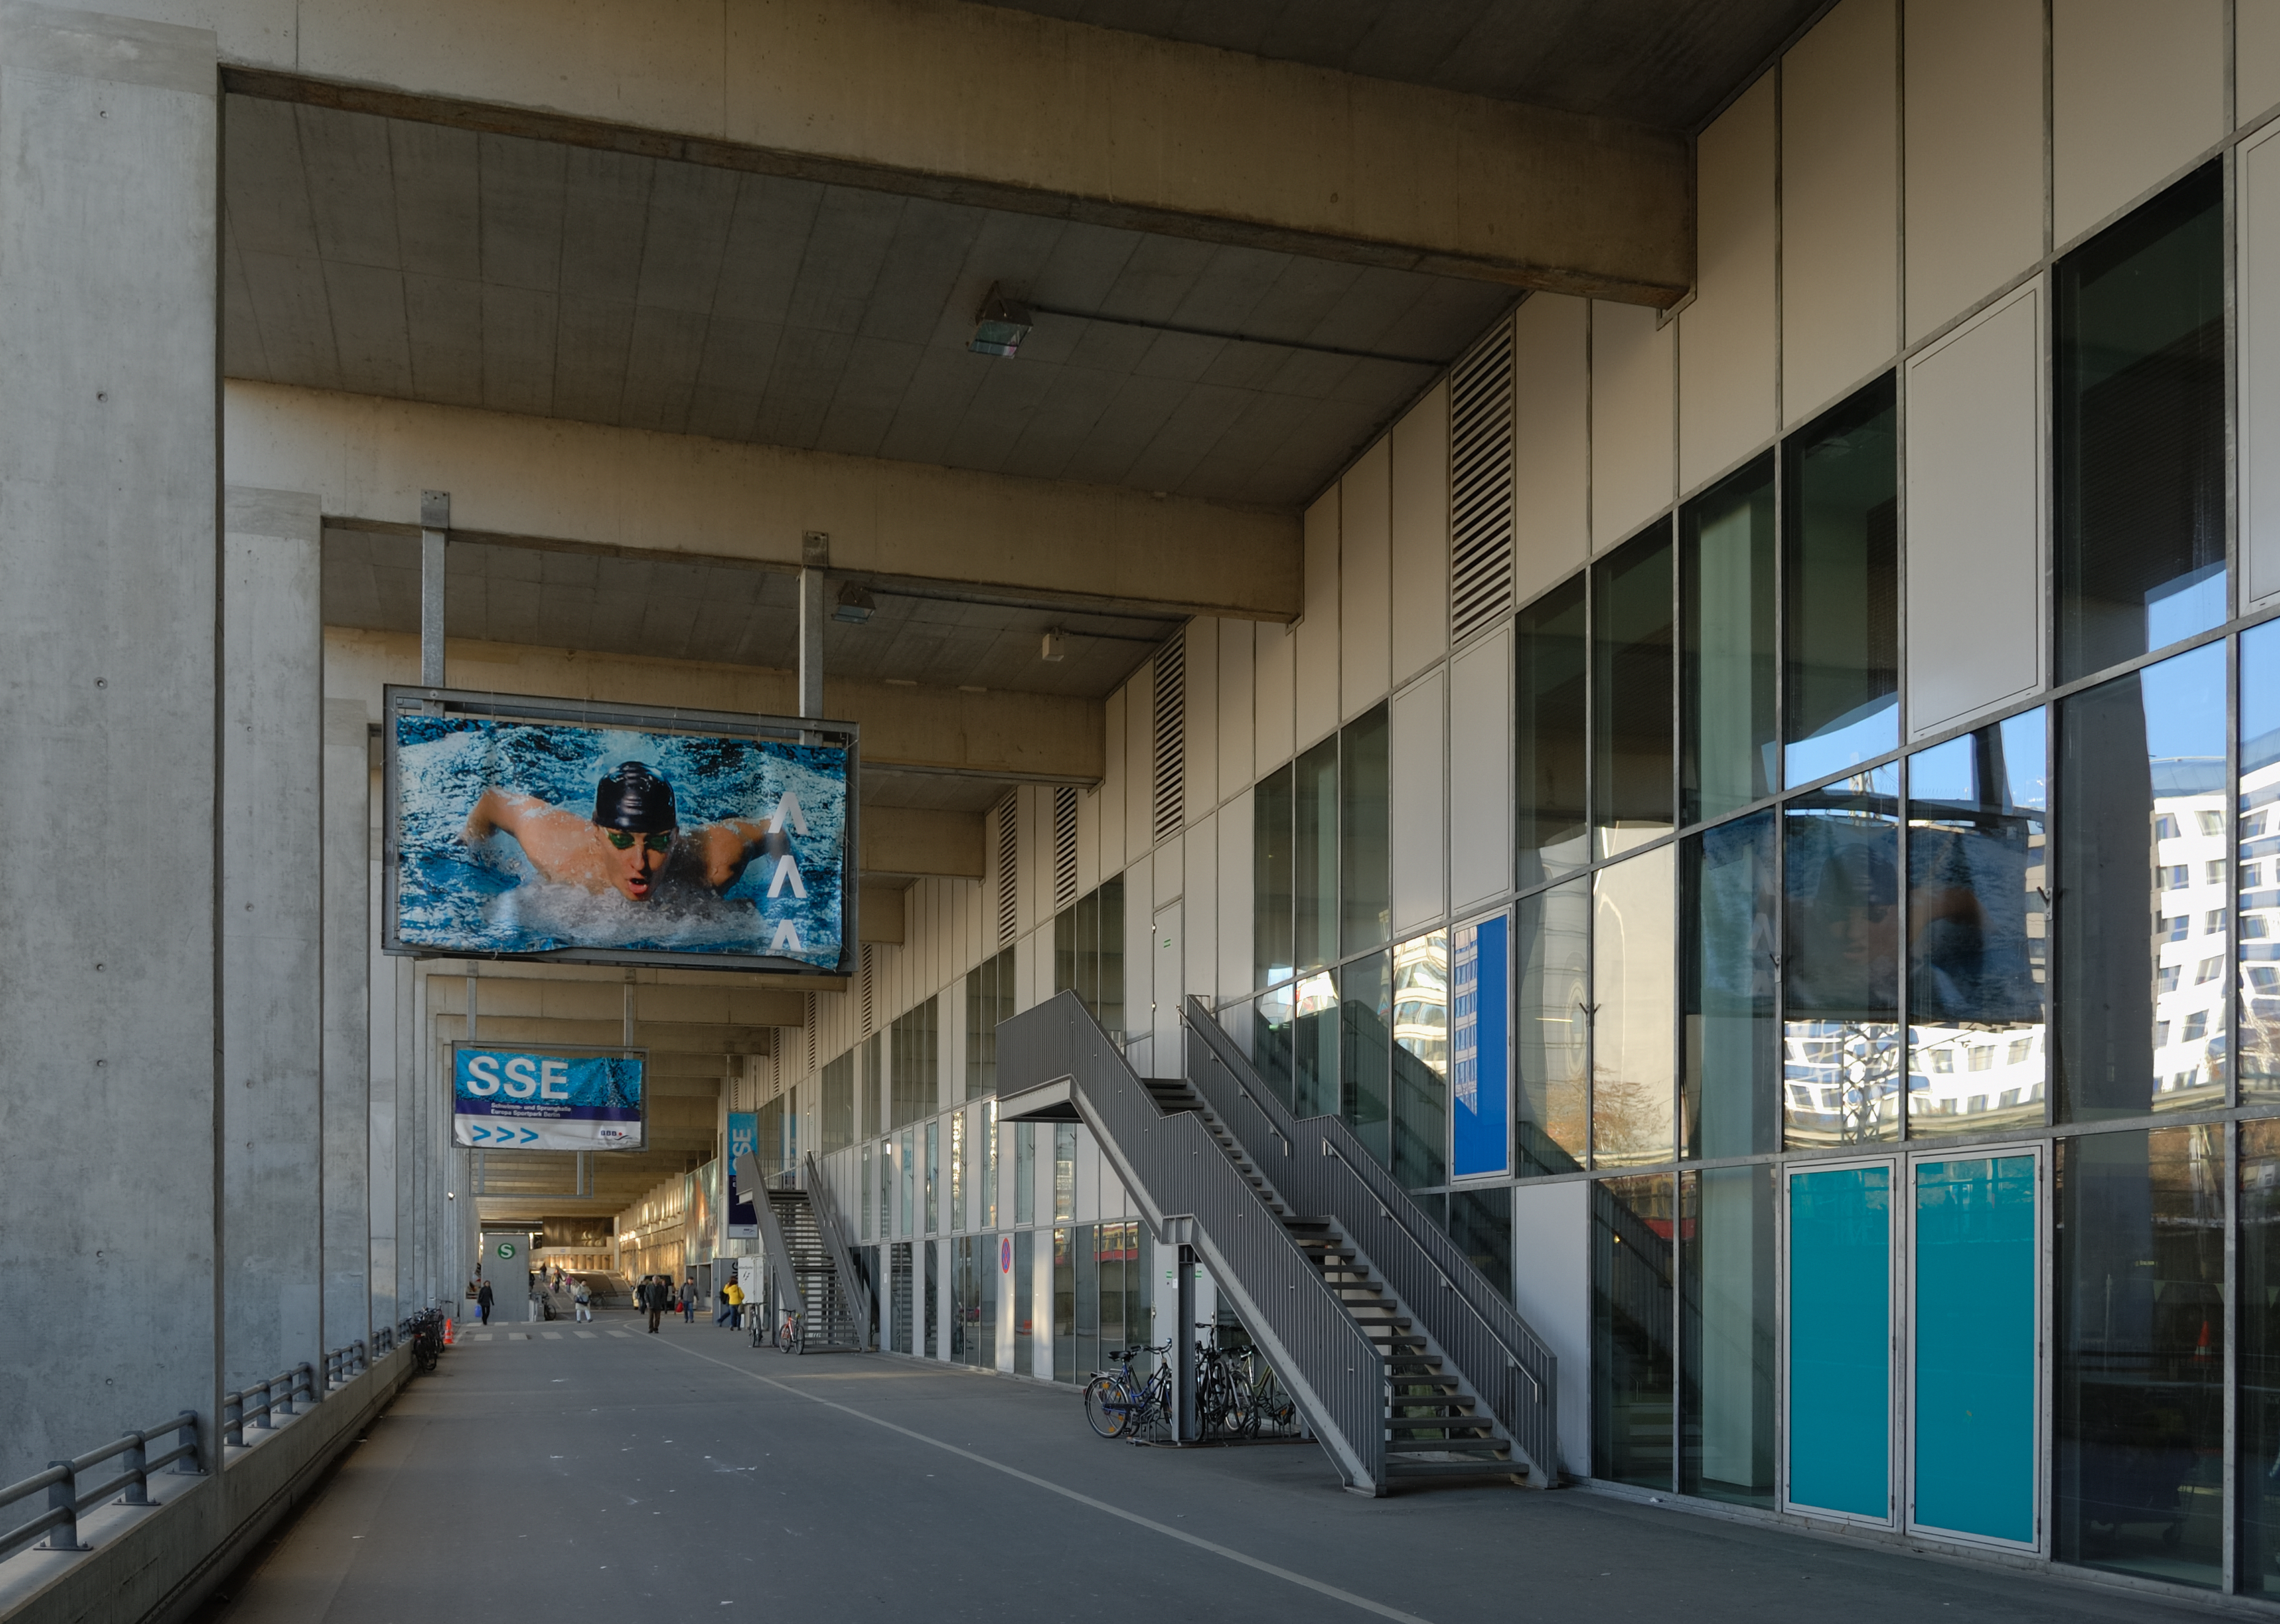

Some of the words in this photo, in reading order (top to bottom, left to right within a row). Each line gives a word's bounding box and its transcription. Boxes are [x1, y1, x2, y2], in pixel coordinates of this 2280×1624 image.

[467, 1056, 568, 1099] SSE
[732, 1129, 751, 1171] SE
[500, 1244, 512, 1258] S
